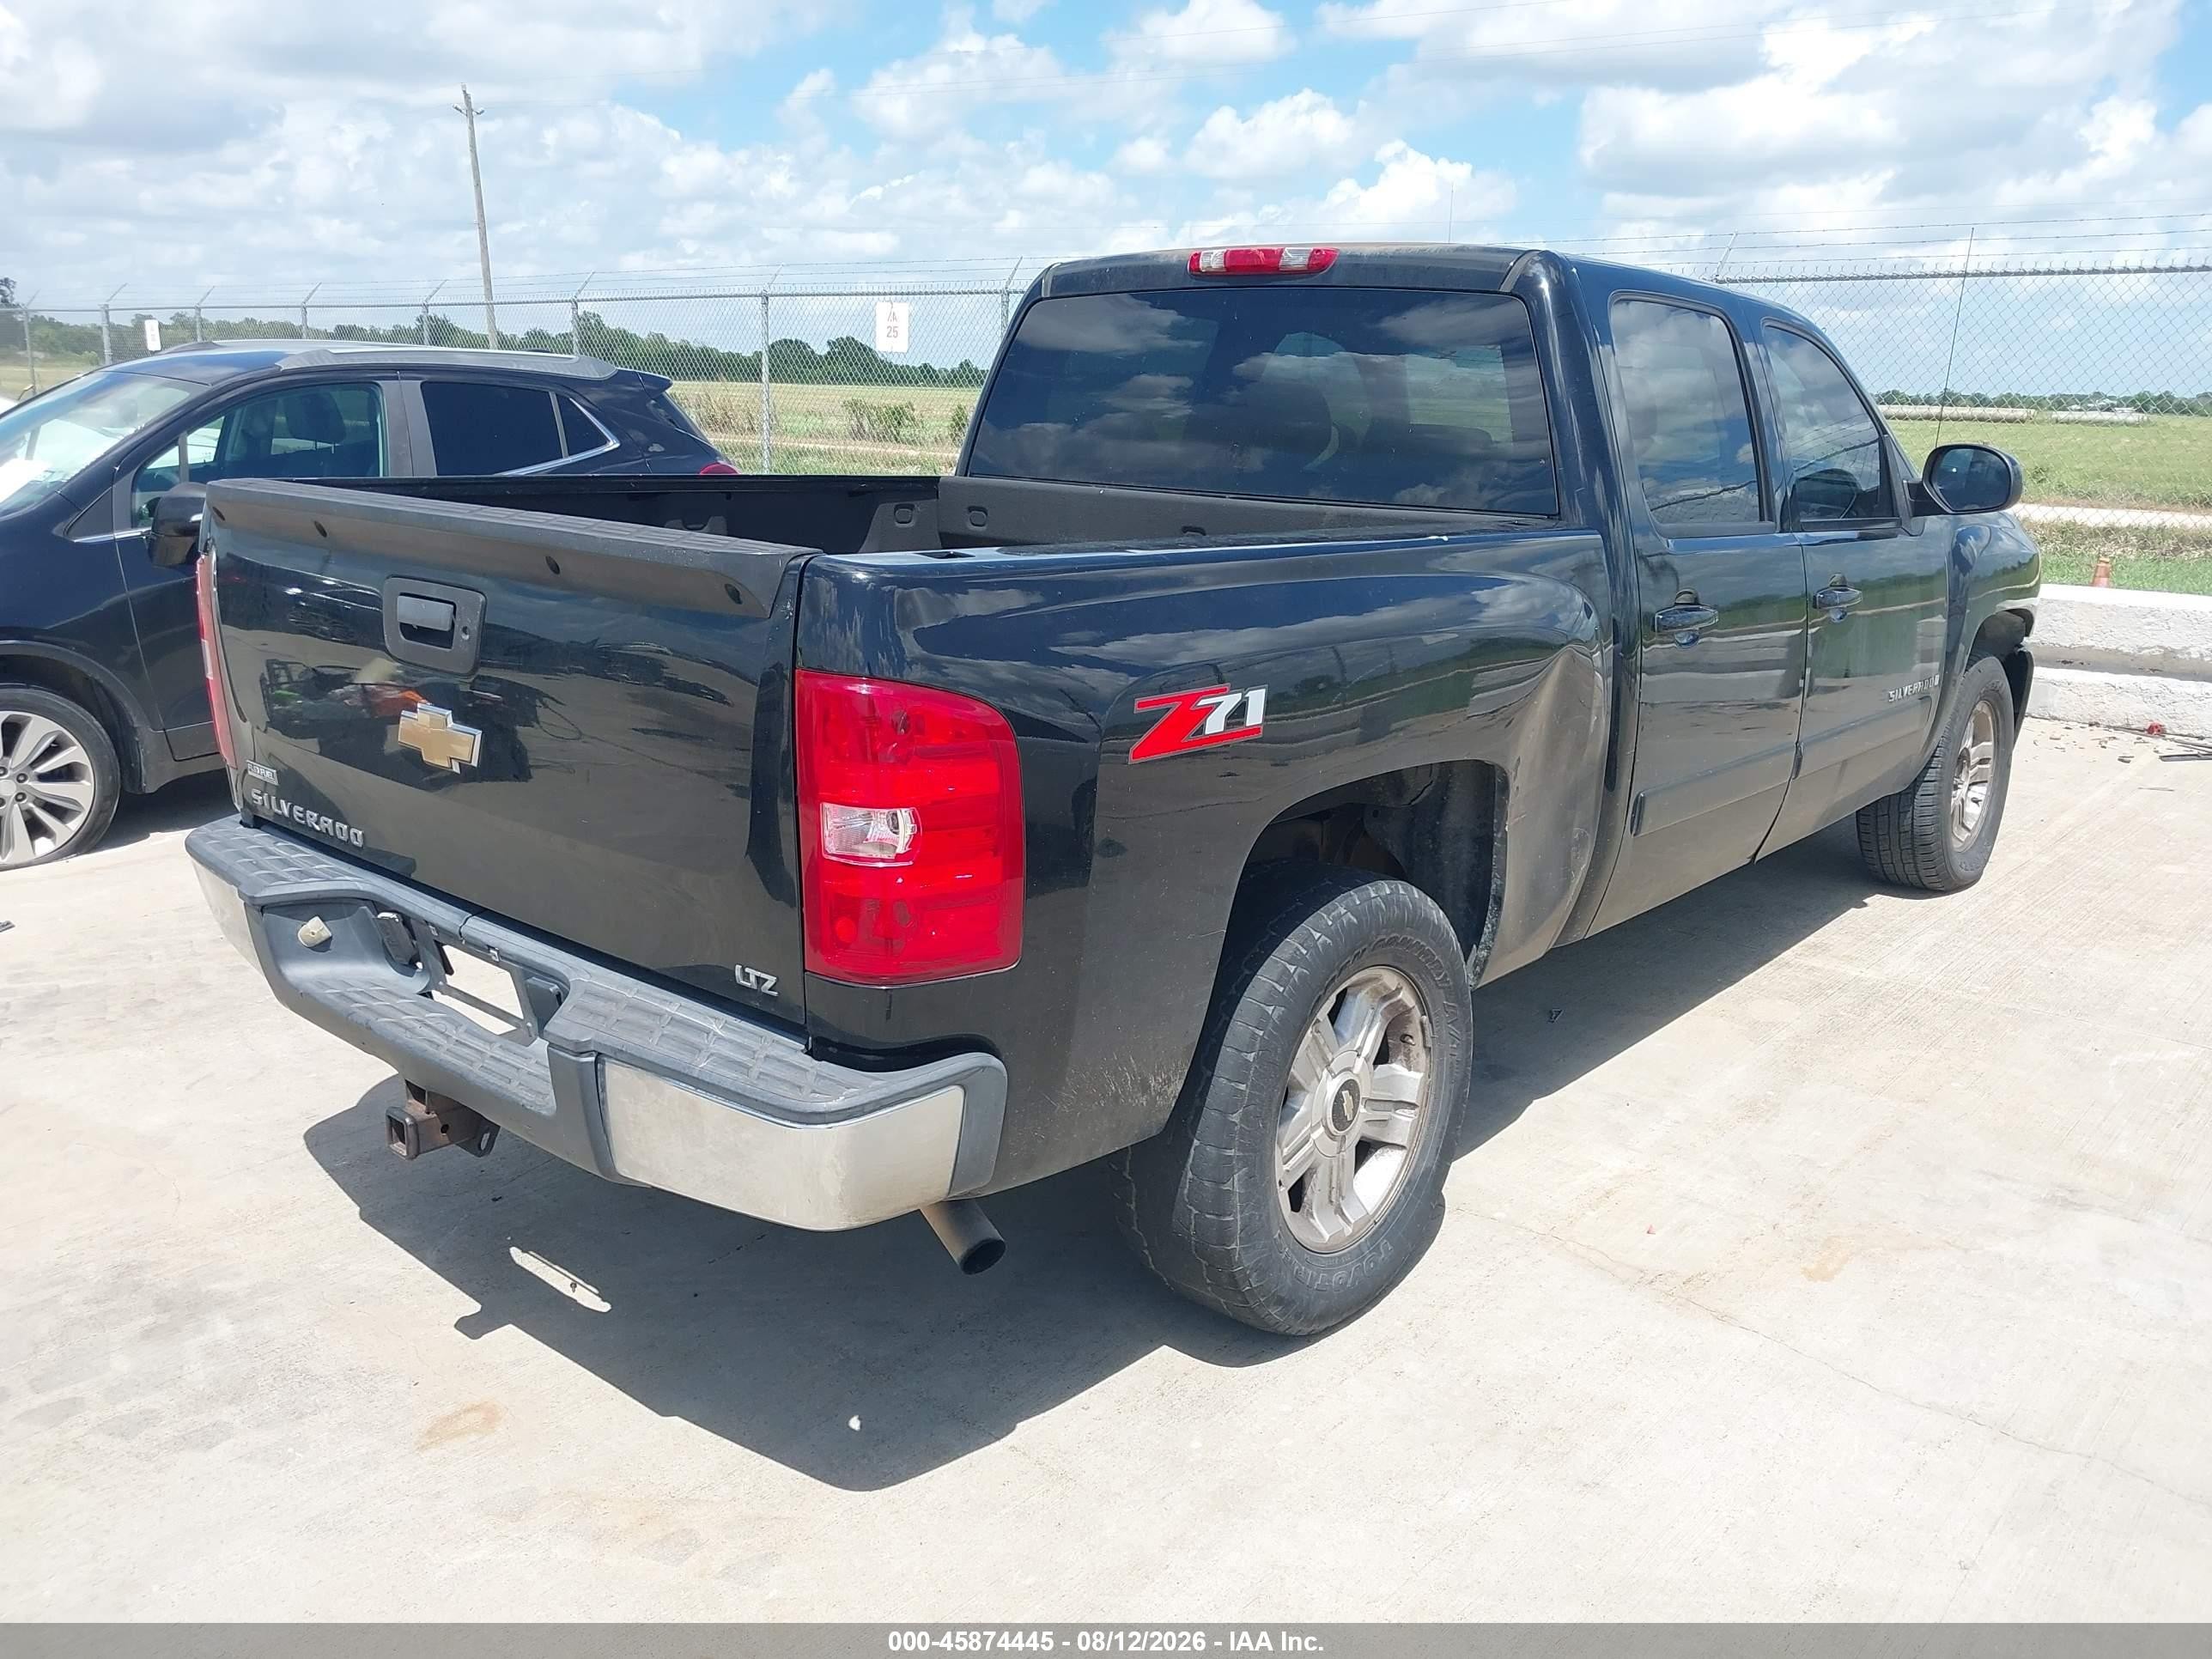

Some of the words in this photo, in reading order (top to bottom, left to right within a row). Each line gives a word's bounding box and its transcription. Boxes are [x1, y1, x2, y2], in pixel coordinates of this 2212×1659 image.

[886, 325, 899, 338] 25
[1888, 674, 1940, 702] SILVERADO
[1128, 683, 1268, 765] Z71
[251, 788, 365, 849] SILVERADO
[735, 963, 779, 997] LTZ
